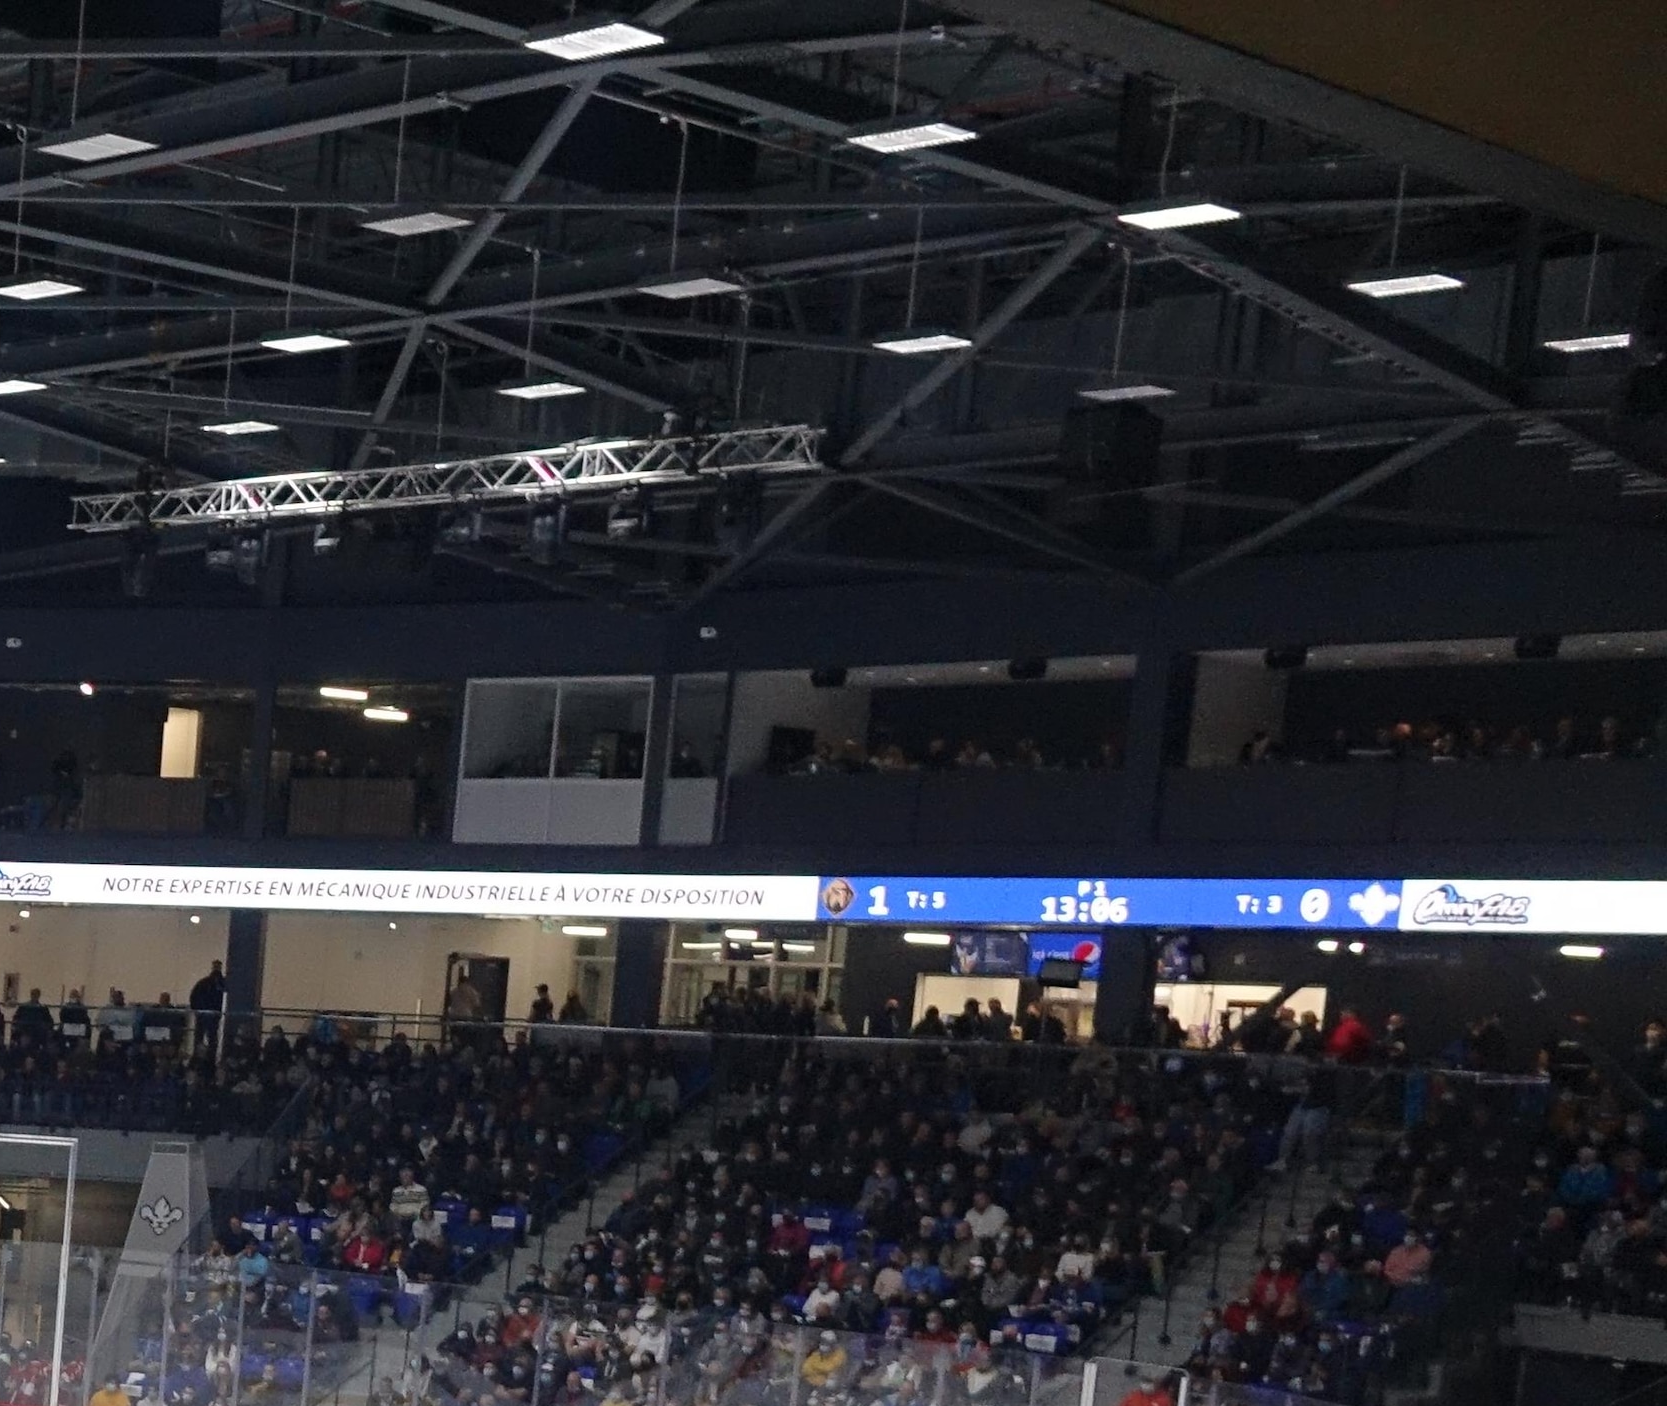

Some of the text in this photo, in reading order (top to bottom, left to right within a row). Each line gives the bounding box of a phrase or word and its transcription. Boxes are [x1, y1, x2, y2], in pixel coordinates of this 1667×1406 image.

[103, 876, 765, 906] NOTRE EXPERTISE EN MÉCANIQUE INDUSTRIELLE À VOTRE DISPOSITION
[868, 886, 889, 915] 1
[1300, 888, 1330, 922] 0
[1041, 896, 1128, 922] 13:06
